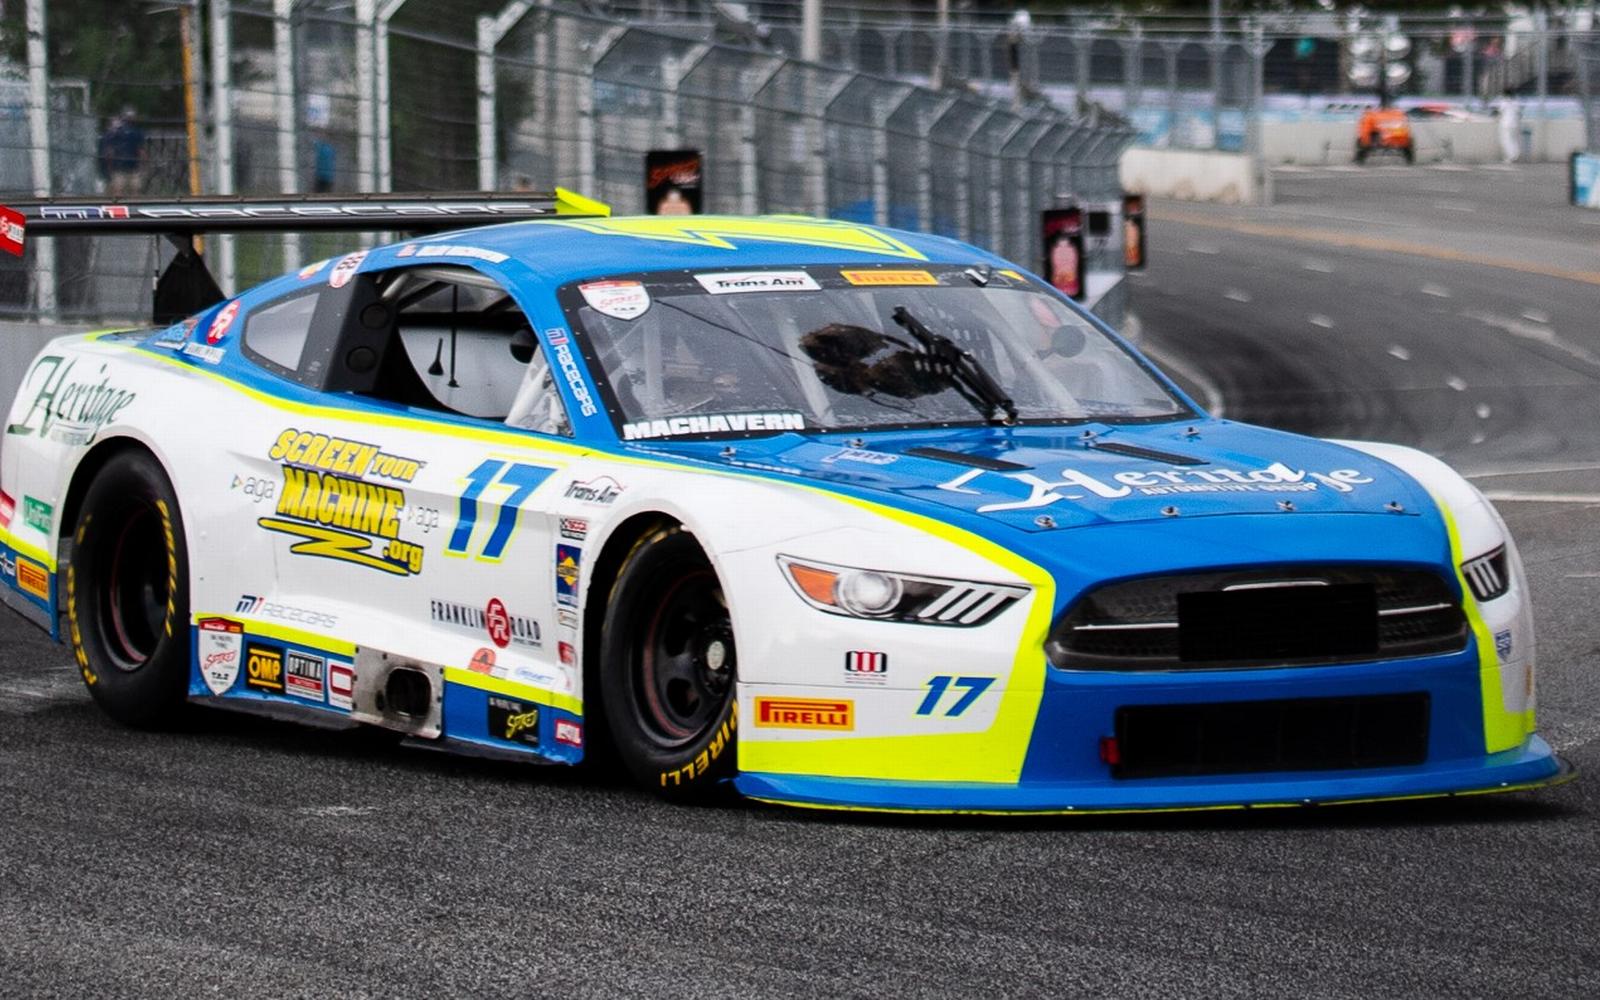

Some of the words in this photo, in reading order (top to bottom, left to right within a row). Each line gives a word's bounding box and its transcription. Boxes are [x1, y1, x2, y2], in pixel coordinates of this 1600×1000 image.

[716, 280, 768, 288] Trans
[772, 278, 804, 286] Am
[7, 356, 136, 445] Heritage
[623, 414, 805, 440] MACHAVERN
[269, 428, 380, 479] SCREEN
[370, 453, 422, 482] YOUR
[243, 476, 274, 502] aga
[276, 464, 405, 539] MACHINE
[936, 462, 1374, 512] Heritage
[445, 455, 564, 562] 17
[383, 540, 424, 575] .org
[431, 600, 487, 629] FRANKLIN
[510, 616, 541, 641] ROAD
[249, 655, 281, 681] OMP
[760, 700, 848, 726] PIRELLI
[914, 674, 999, 718] 17
[660, 699, 738, 786] PIRELLI
